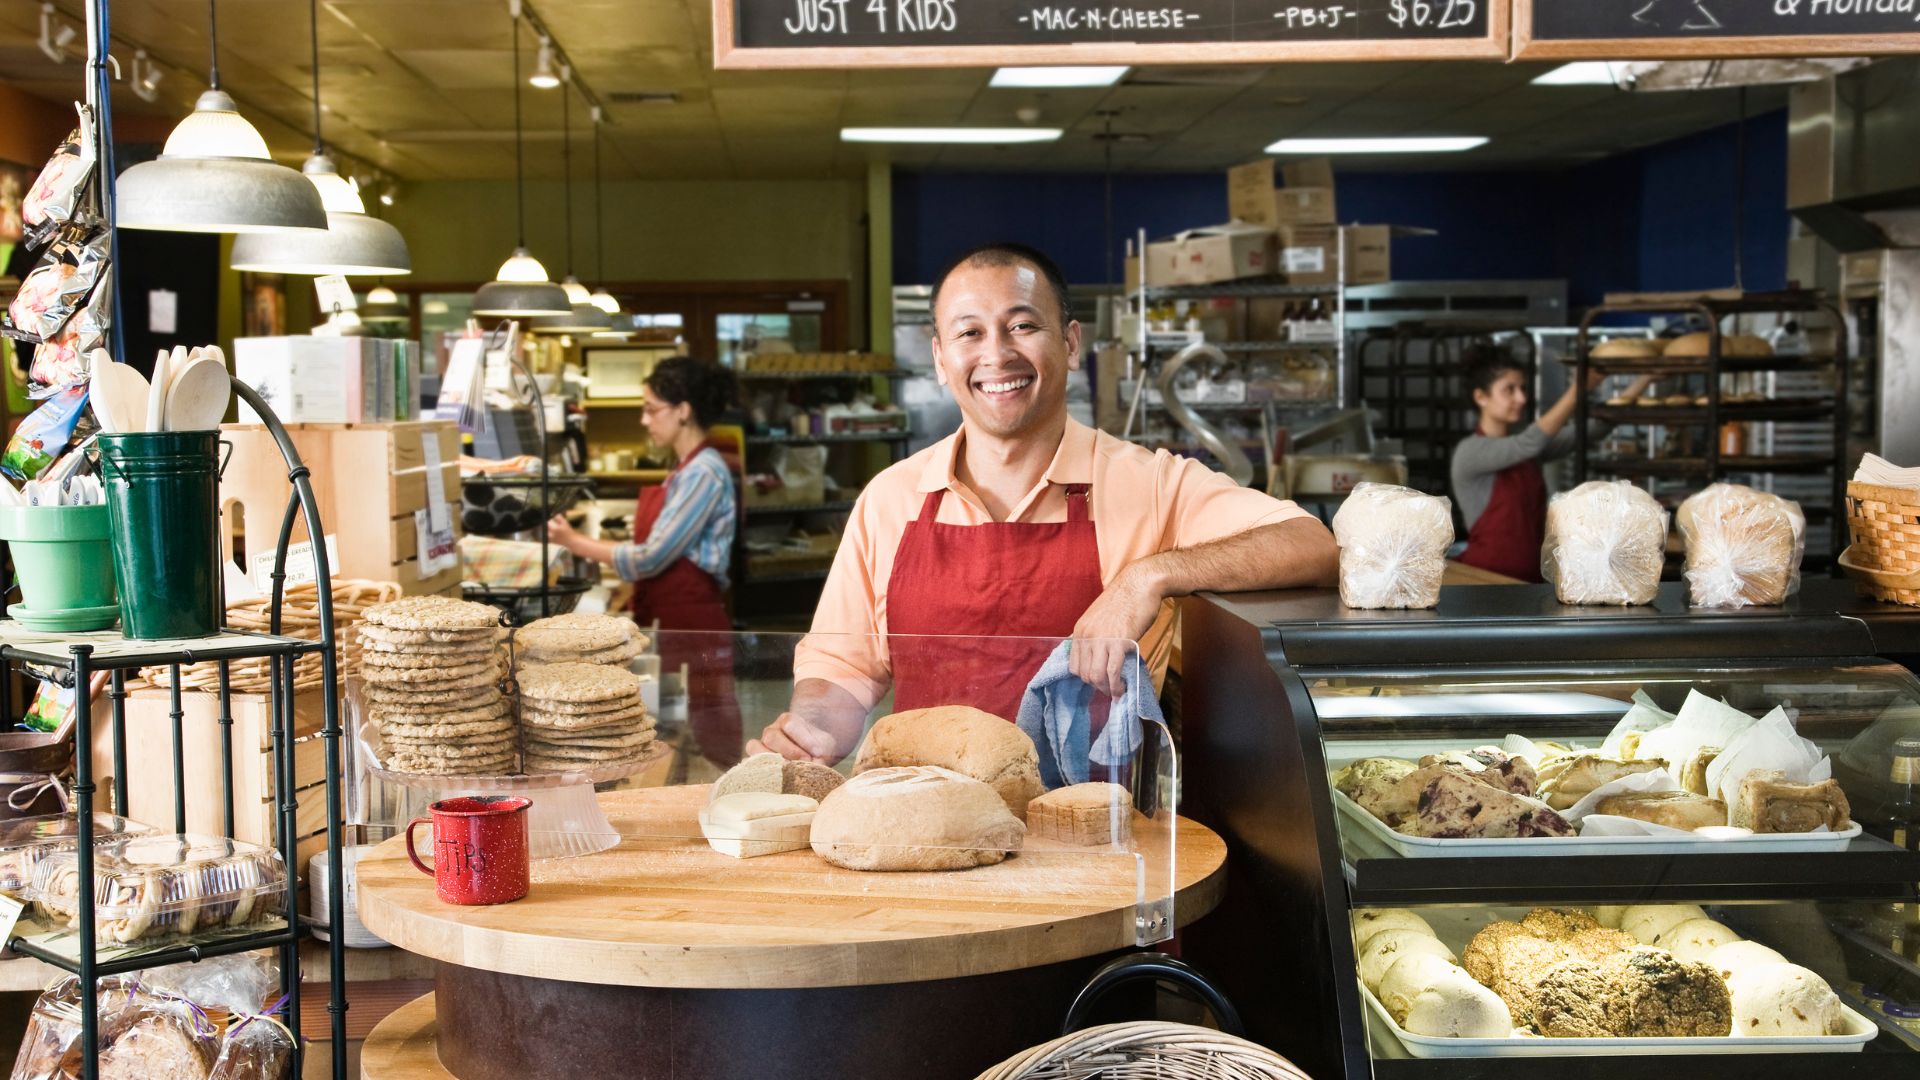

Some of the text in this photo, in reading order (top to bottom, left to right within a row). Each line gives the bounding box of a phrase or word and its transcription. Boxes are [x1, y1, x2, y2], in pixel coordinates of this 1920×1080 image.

[785, 0, 848, 34] JUST
[866, 0, 887, 33] 4
[898, 0, 956, 32] KIDS
[1388, 0, 1475, 28] $6.25
